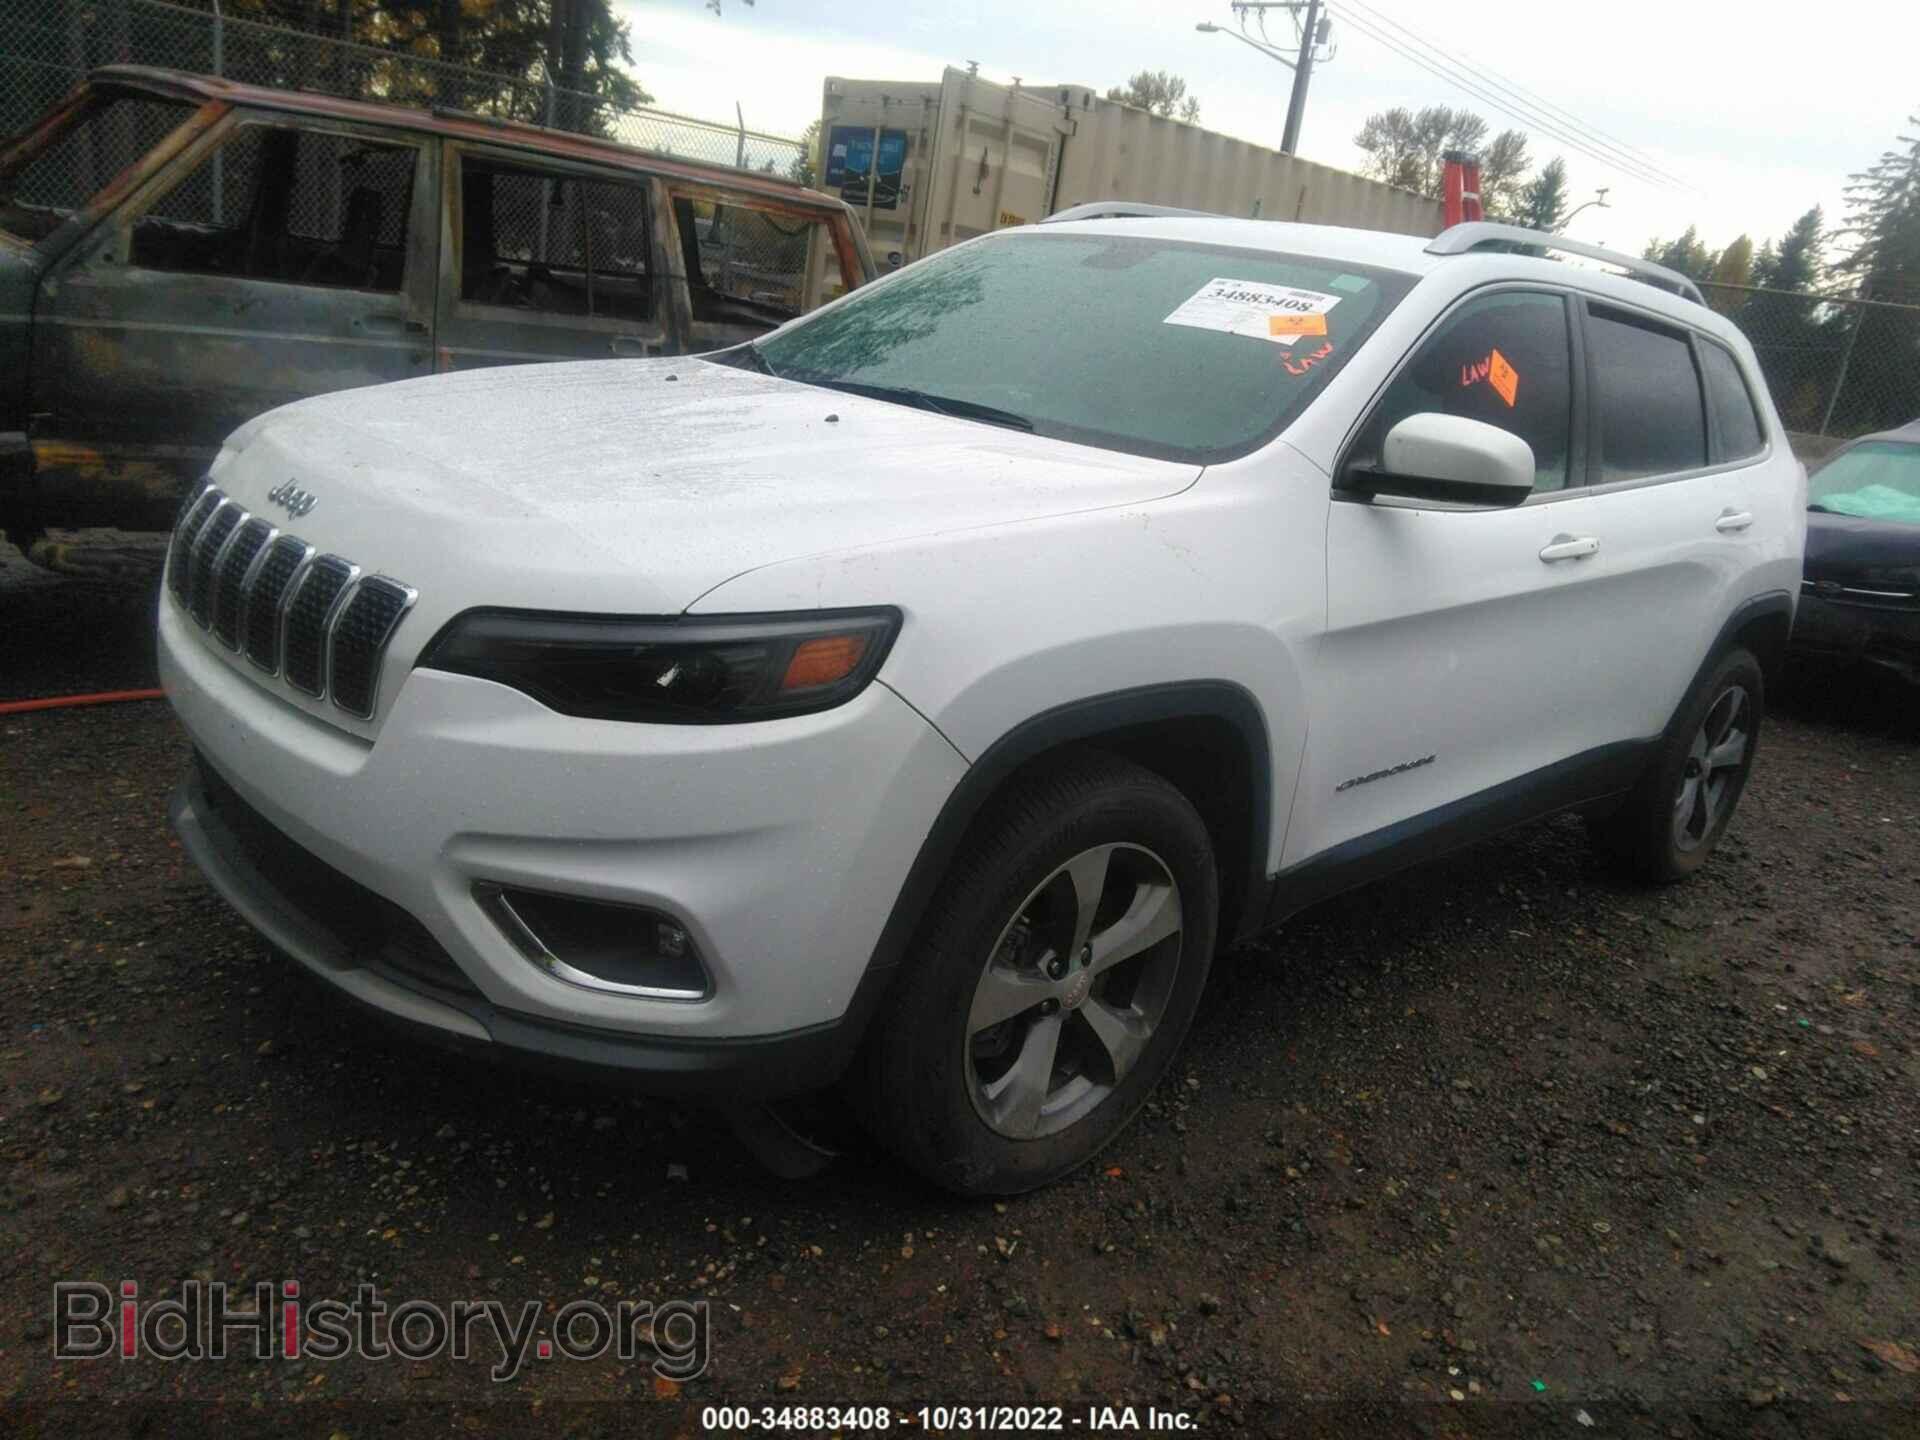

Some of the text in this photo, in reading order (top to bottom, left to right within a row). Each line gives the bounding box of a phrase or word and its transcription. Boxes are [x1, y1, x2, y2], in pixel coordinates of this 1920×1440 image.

[1208, 287, 1313, 313] 34883408
[1461, 356, 1490, 386] LAW
[267, 477, 318, 520] Jeep
